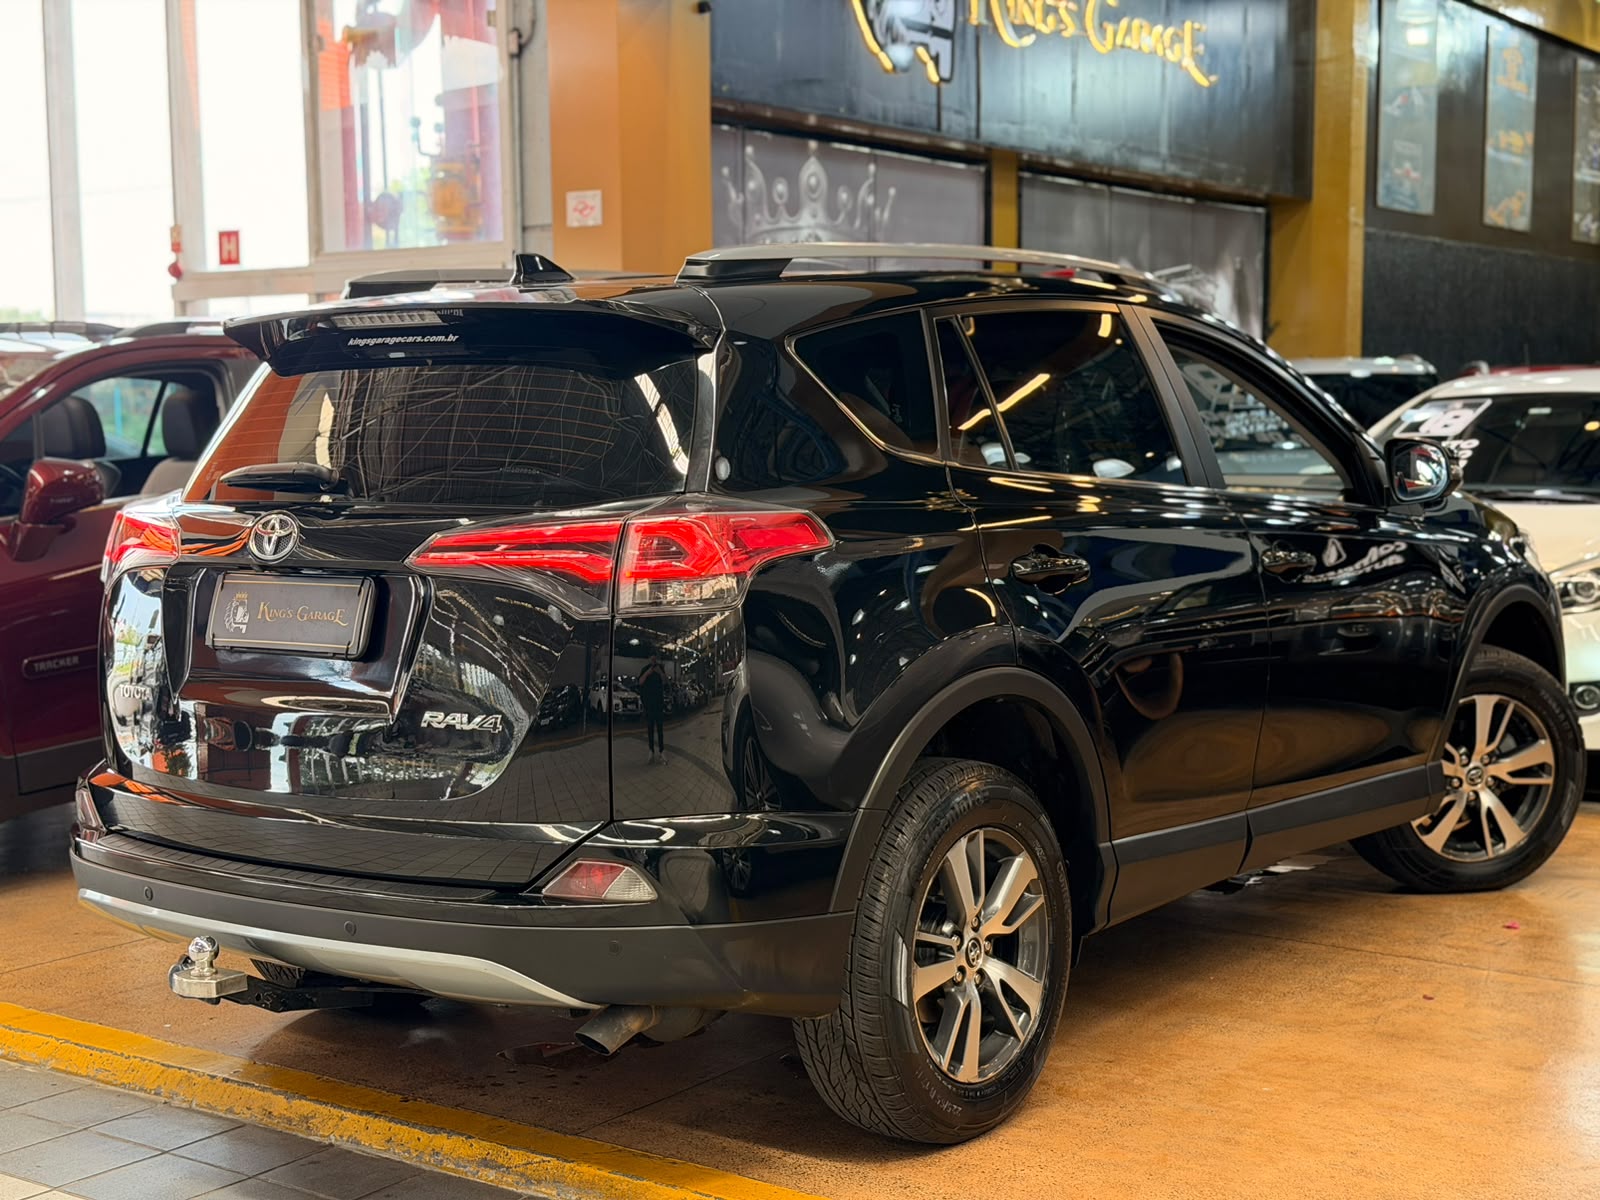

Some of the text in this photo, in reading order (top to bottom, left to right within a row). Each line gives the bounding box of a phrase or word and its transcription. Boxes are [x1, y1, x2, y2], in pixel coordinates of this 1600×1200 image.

[347, 333, 460, 347] kingsgaragecars.com.br
[33, 655, 80, 673] TRACKER
[118, 684, 153, 701] TOYOTA
[420, 710, 503, 734] RAV4
